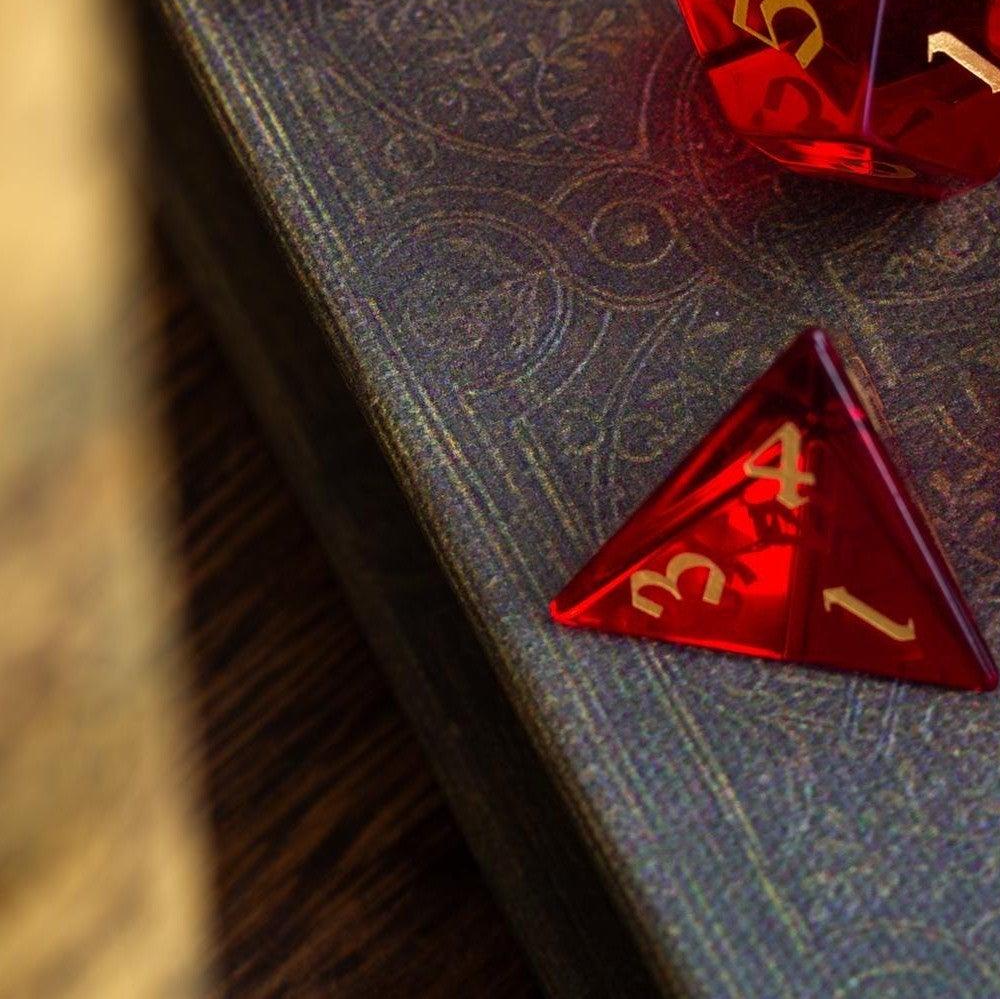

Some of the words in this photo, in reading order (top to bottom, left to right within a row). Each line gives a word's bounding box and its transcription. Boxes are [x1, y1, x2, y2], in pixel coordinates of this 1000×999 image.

[740, 421, 816, 511] 4
[628, 550, 727, 619] 3
[822, 585, 917, 643] 1
